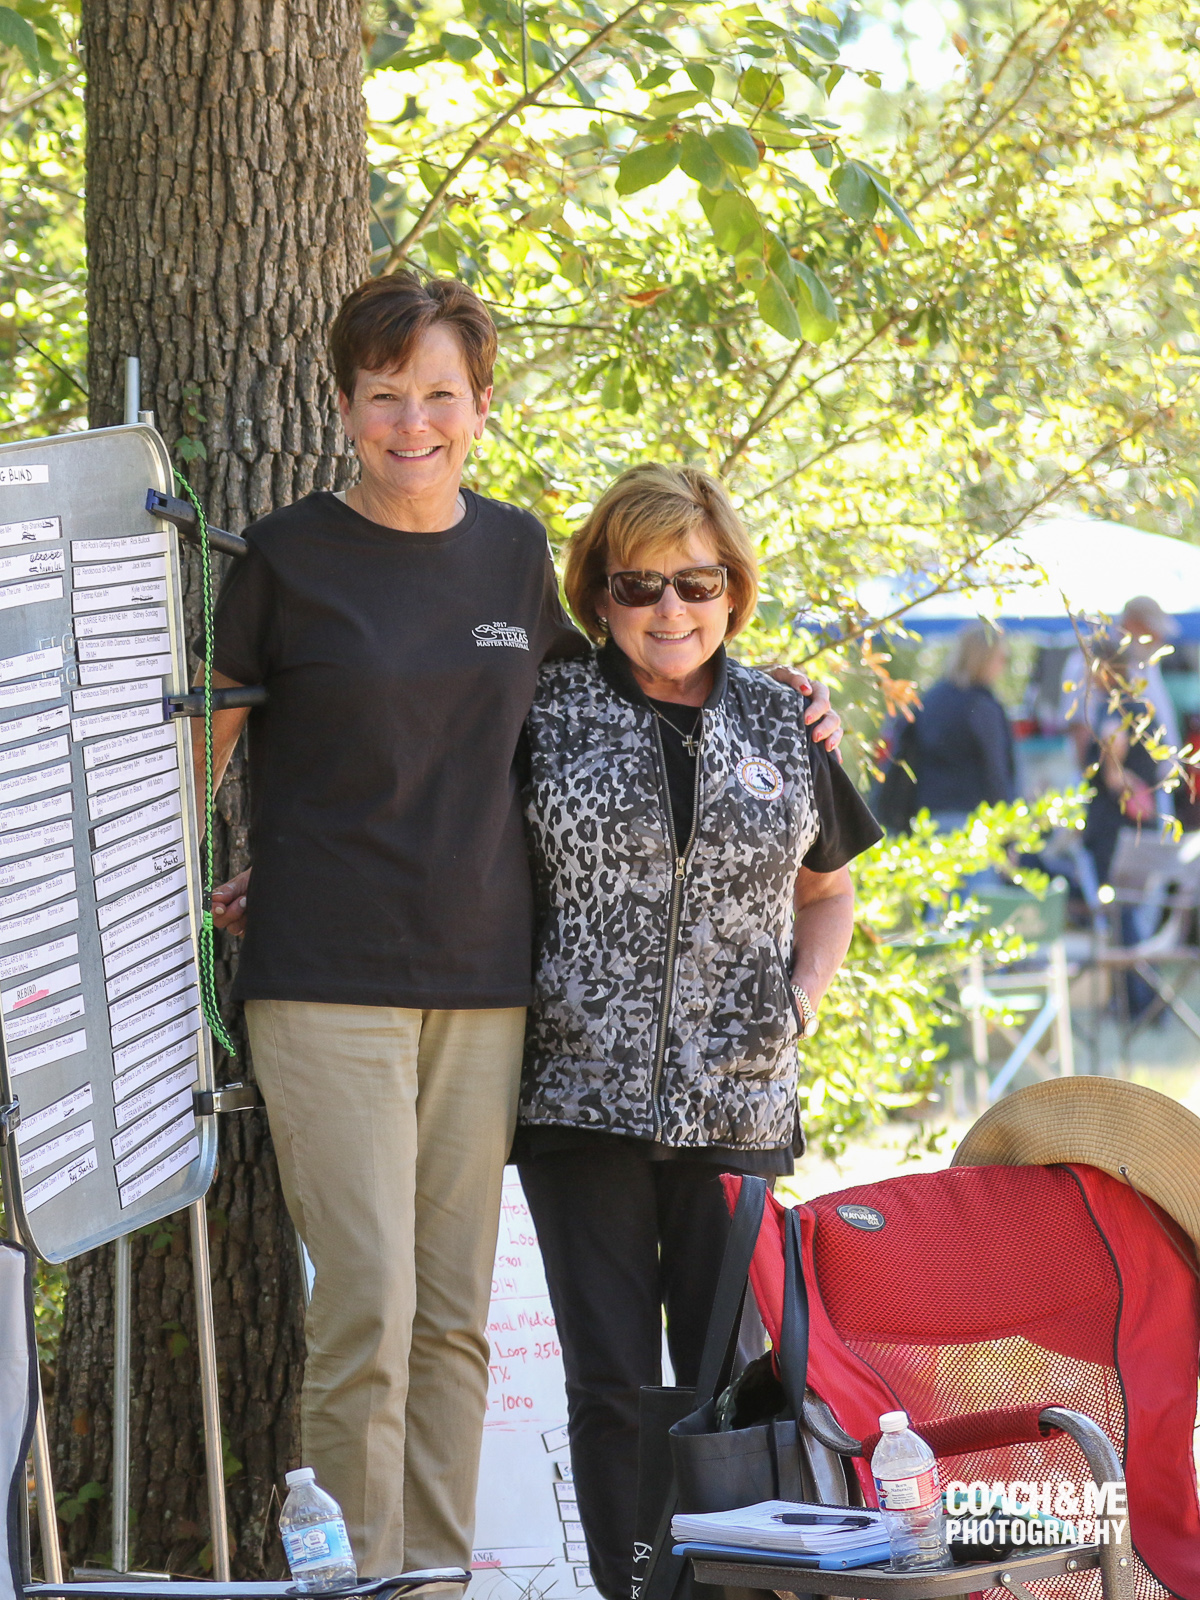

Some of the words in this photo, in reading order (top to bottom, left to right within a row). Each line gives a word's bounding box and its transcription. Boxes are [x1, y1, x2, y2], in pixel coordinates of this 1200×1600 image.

[9, 468, 33, 482] BLIND
[500, 632, 529, 644] TEXAS
[503, 640, 529, 651] NATIONAL
[16, 984, 37, 1001] REBIRD
[507, 1227, 539, 1247] Loo
[495, 1341, 528, 1364] Loop
[534, 1341, 560, 1360] 256
